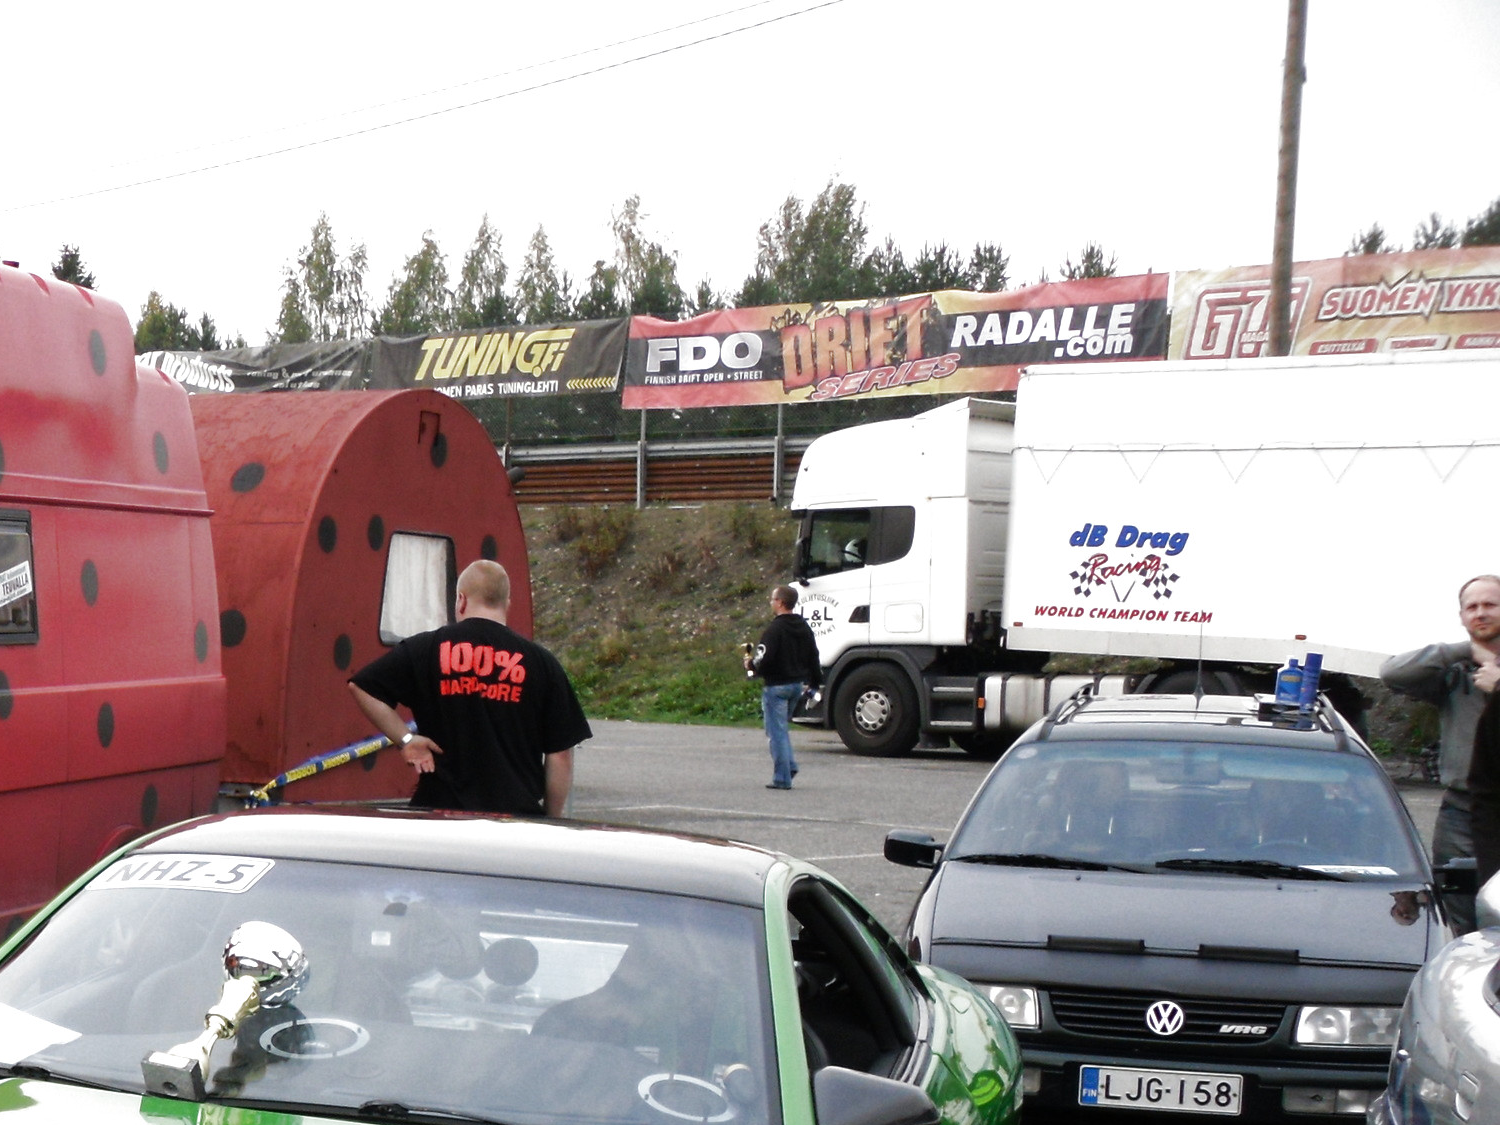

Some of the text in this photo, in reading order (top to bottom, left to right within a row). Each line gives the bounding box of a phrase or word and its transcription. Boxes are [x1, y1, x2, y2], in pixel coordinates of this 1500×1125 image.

[1324, 283, 1436, 316] SUOMEN
[951, 303, 1135, 348] RADALLE
[646, 332, 763, 373] FDO
[782, 294, 932, 391] DRIFT
[1054, 333, 1134, 358] .com
[465, 384, 494, 397] PARAS
[498, 380, 559, 395] TUNINGLEHTI
[679, 373, 701, 383] DRIFT
[703, 372, 724, 382] OPEN
[734, 371, 764, 381] STREET
[811, 353, 960, 401] SERIES
[1069, 523, 1189, 556] dB Drag
[1088, 553, 1161, 585] Racing
[1034, 605, 1213, 624] WORLD CHAMPION TEAM
[440, 641, 526, 683] 100%
[440, 676, 522, 703] HARDCORE
[106, 861, 255, 884] NHZ-5
[1082, 1088, 1097, 1098] FIN
[1104, 1074, 1232, 1107] LJG-158
